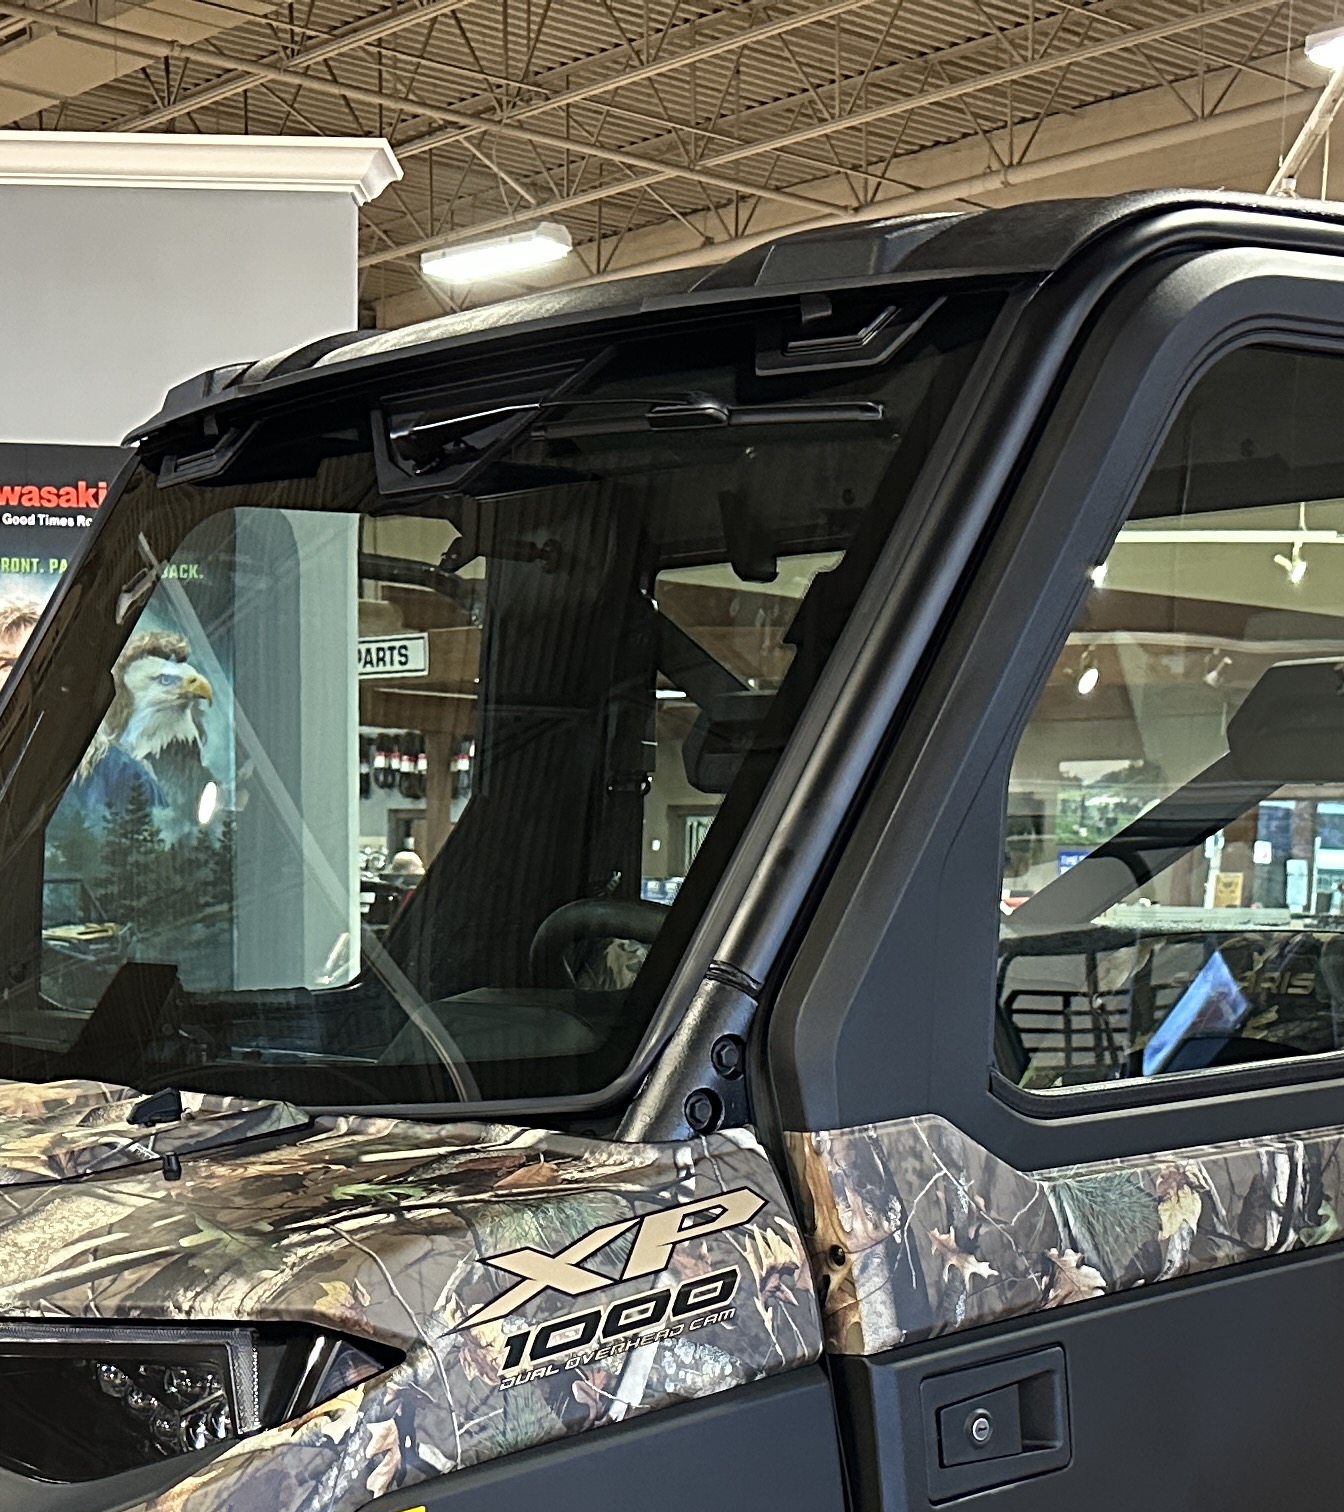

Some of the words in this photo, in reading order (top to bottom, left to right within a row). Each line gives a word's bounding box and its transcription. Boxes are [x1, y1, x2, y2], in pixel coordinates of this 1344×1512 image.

[2, 513, 36, 527] Good
[37, 514, 75, 527] Times
[440, 1186, 769, 1338] XP
[498, 1264, 742, 1376] 1000
[499, 1364, 560, 1391] DUAL
[564, 1322, 686, 1370] OVERHEAD
[688, 1307, 737, 1331] CAM
